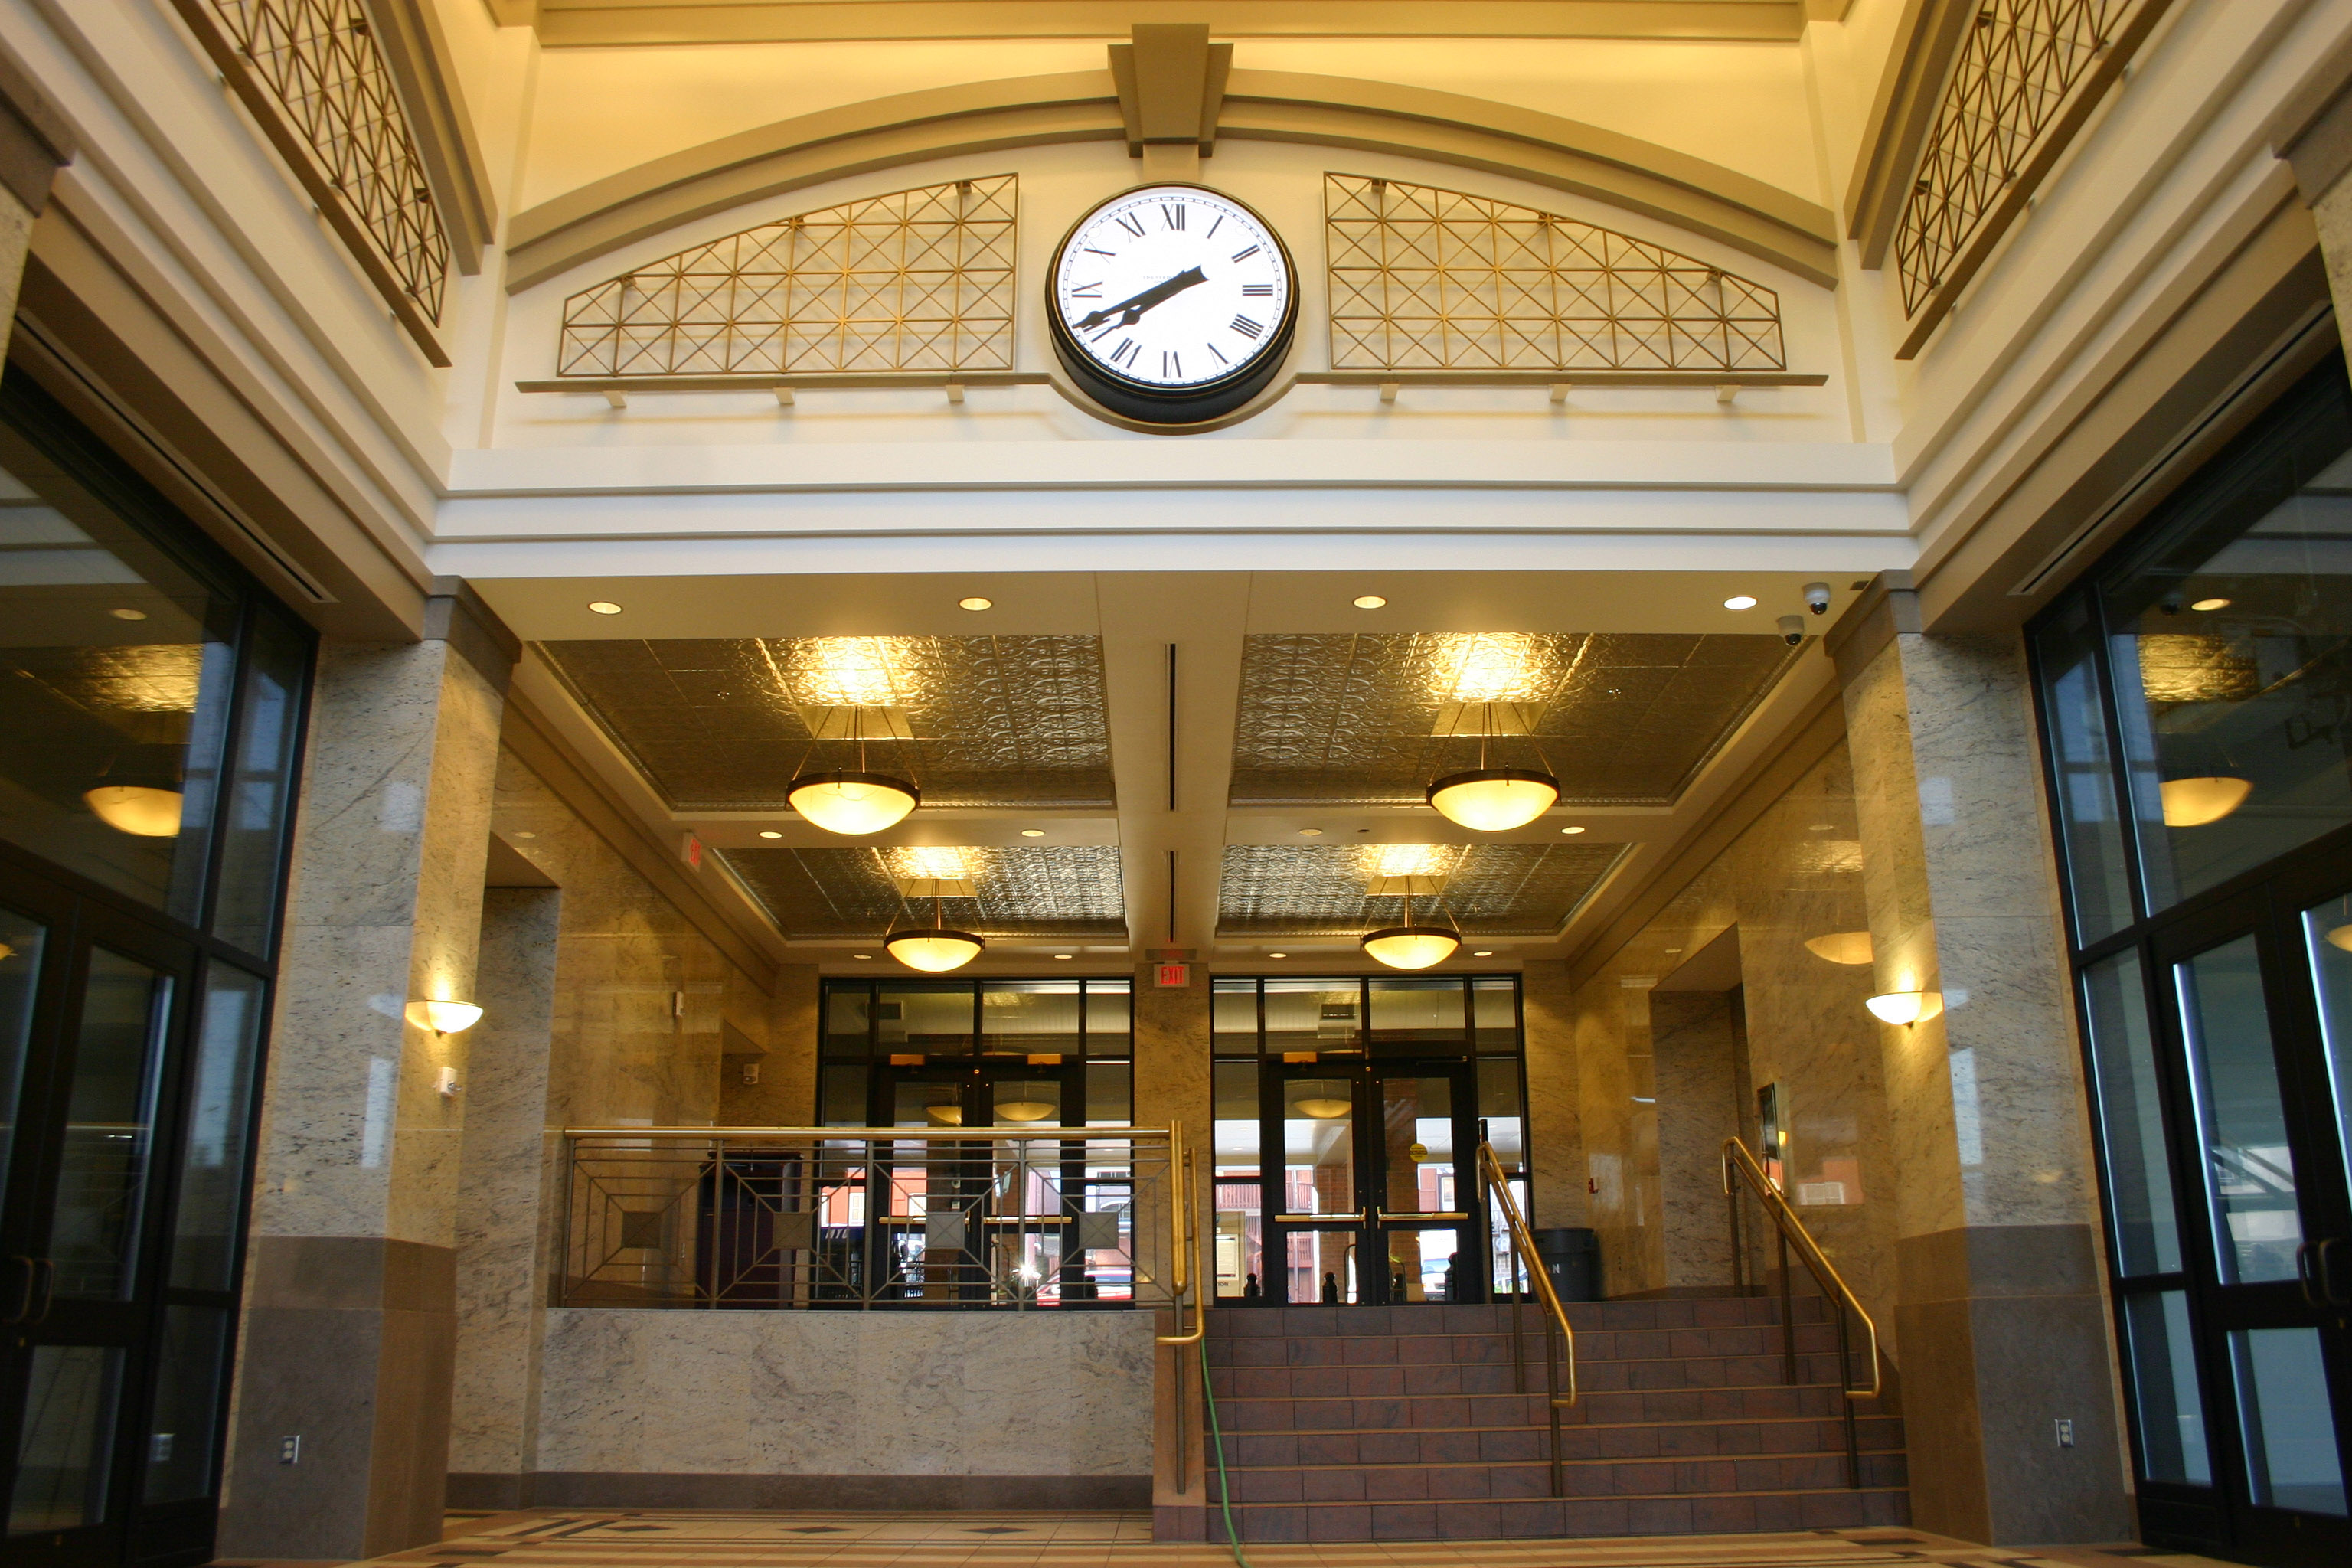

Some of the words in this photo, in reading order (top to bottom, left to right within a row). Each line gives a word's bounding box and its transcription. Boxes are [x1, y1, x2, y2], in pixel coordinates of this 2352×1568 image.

[1116, 211, 1146, 243] XI
[1161, 204, 1186, 231] XII
[1206, 215, 1223, 239] I
[1083, 240, 1117, 265] X
[1231, 244, 1260, 263] II
[1072, 281, 1102, 298] IX
[1242, 284, 1273, 296] III
[1229, 313, 1264, 340] IIII
[1109, 337, 1142, 369] VII
[1162, 351, 1182, 378] VI
[1207, 342, 1229, 370] V
[1161, 966, 1184, 985] EXIT
